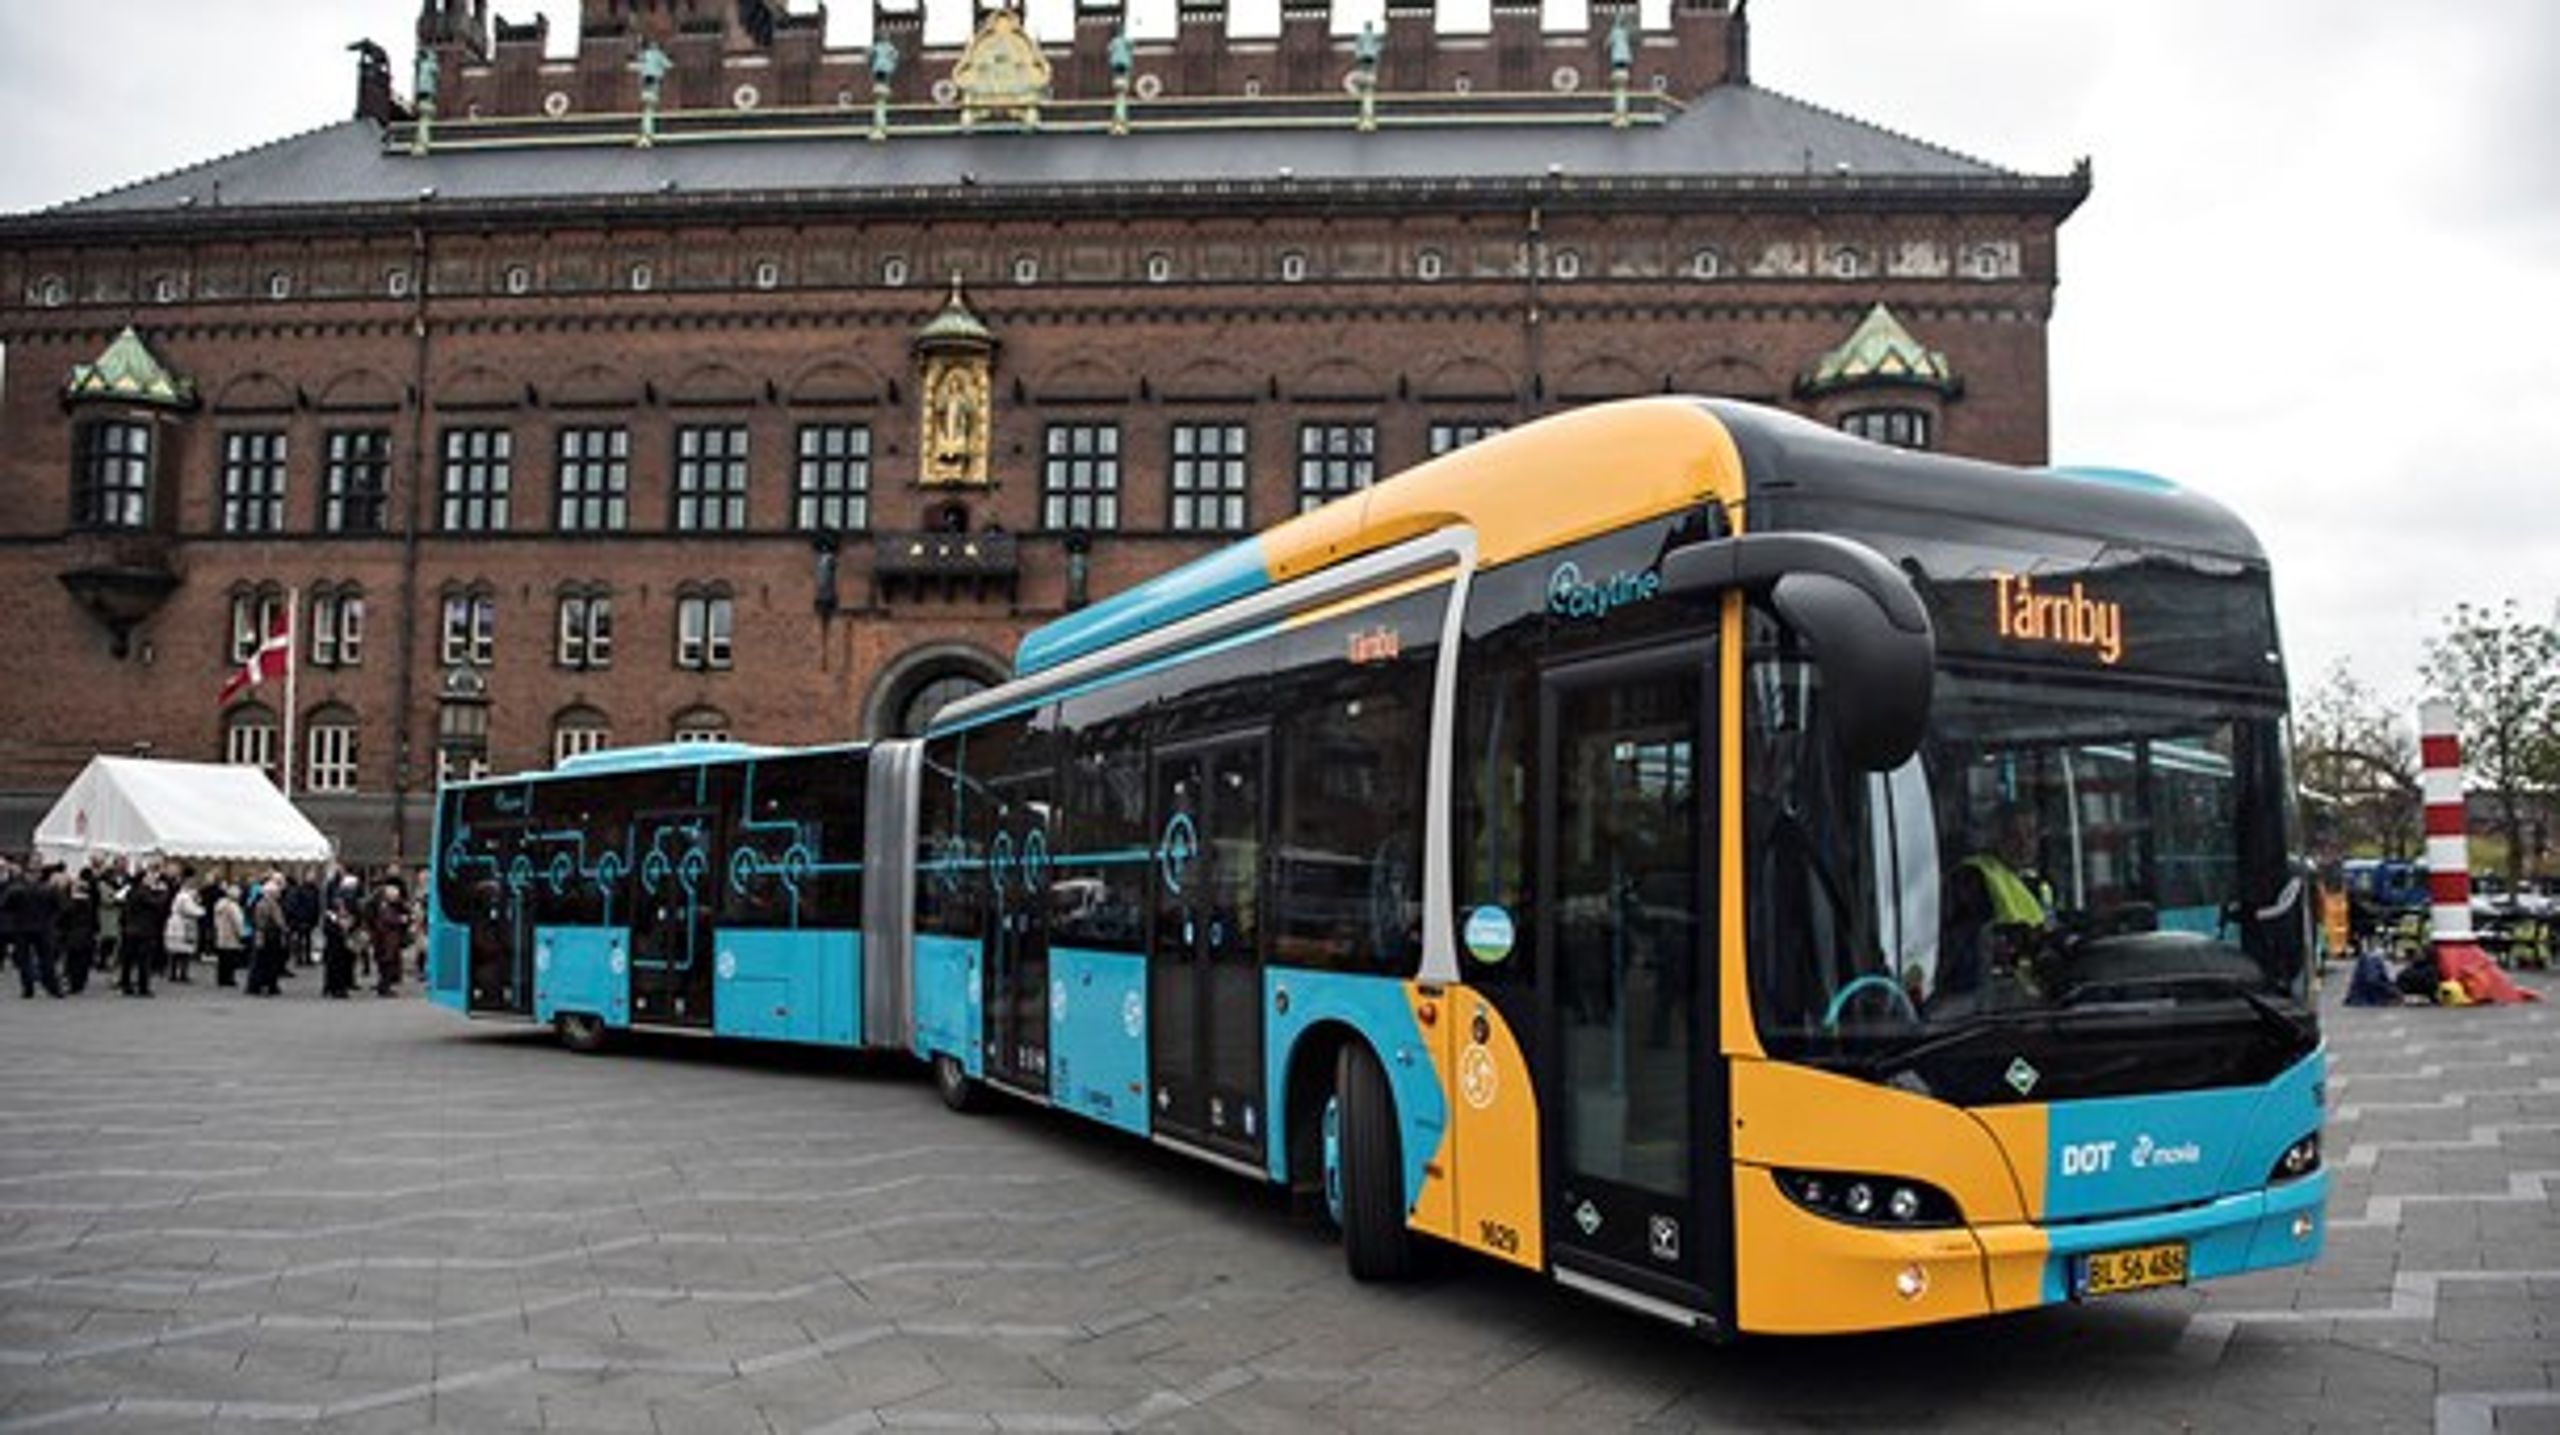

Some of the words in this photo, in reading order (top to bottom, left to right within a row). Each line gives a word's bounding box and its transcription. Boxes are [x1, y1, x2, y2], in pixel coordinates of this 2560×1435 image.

[1989, 570, 2121, 664] Tårnby
[2062, 1140, 2117, 1176] DOT
[1480, 1219, 1520, 1255] 1629
[2090, 1258, 2116, 1288] BL
[2121, 1254, 2145, 1285] 56
